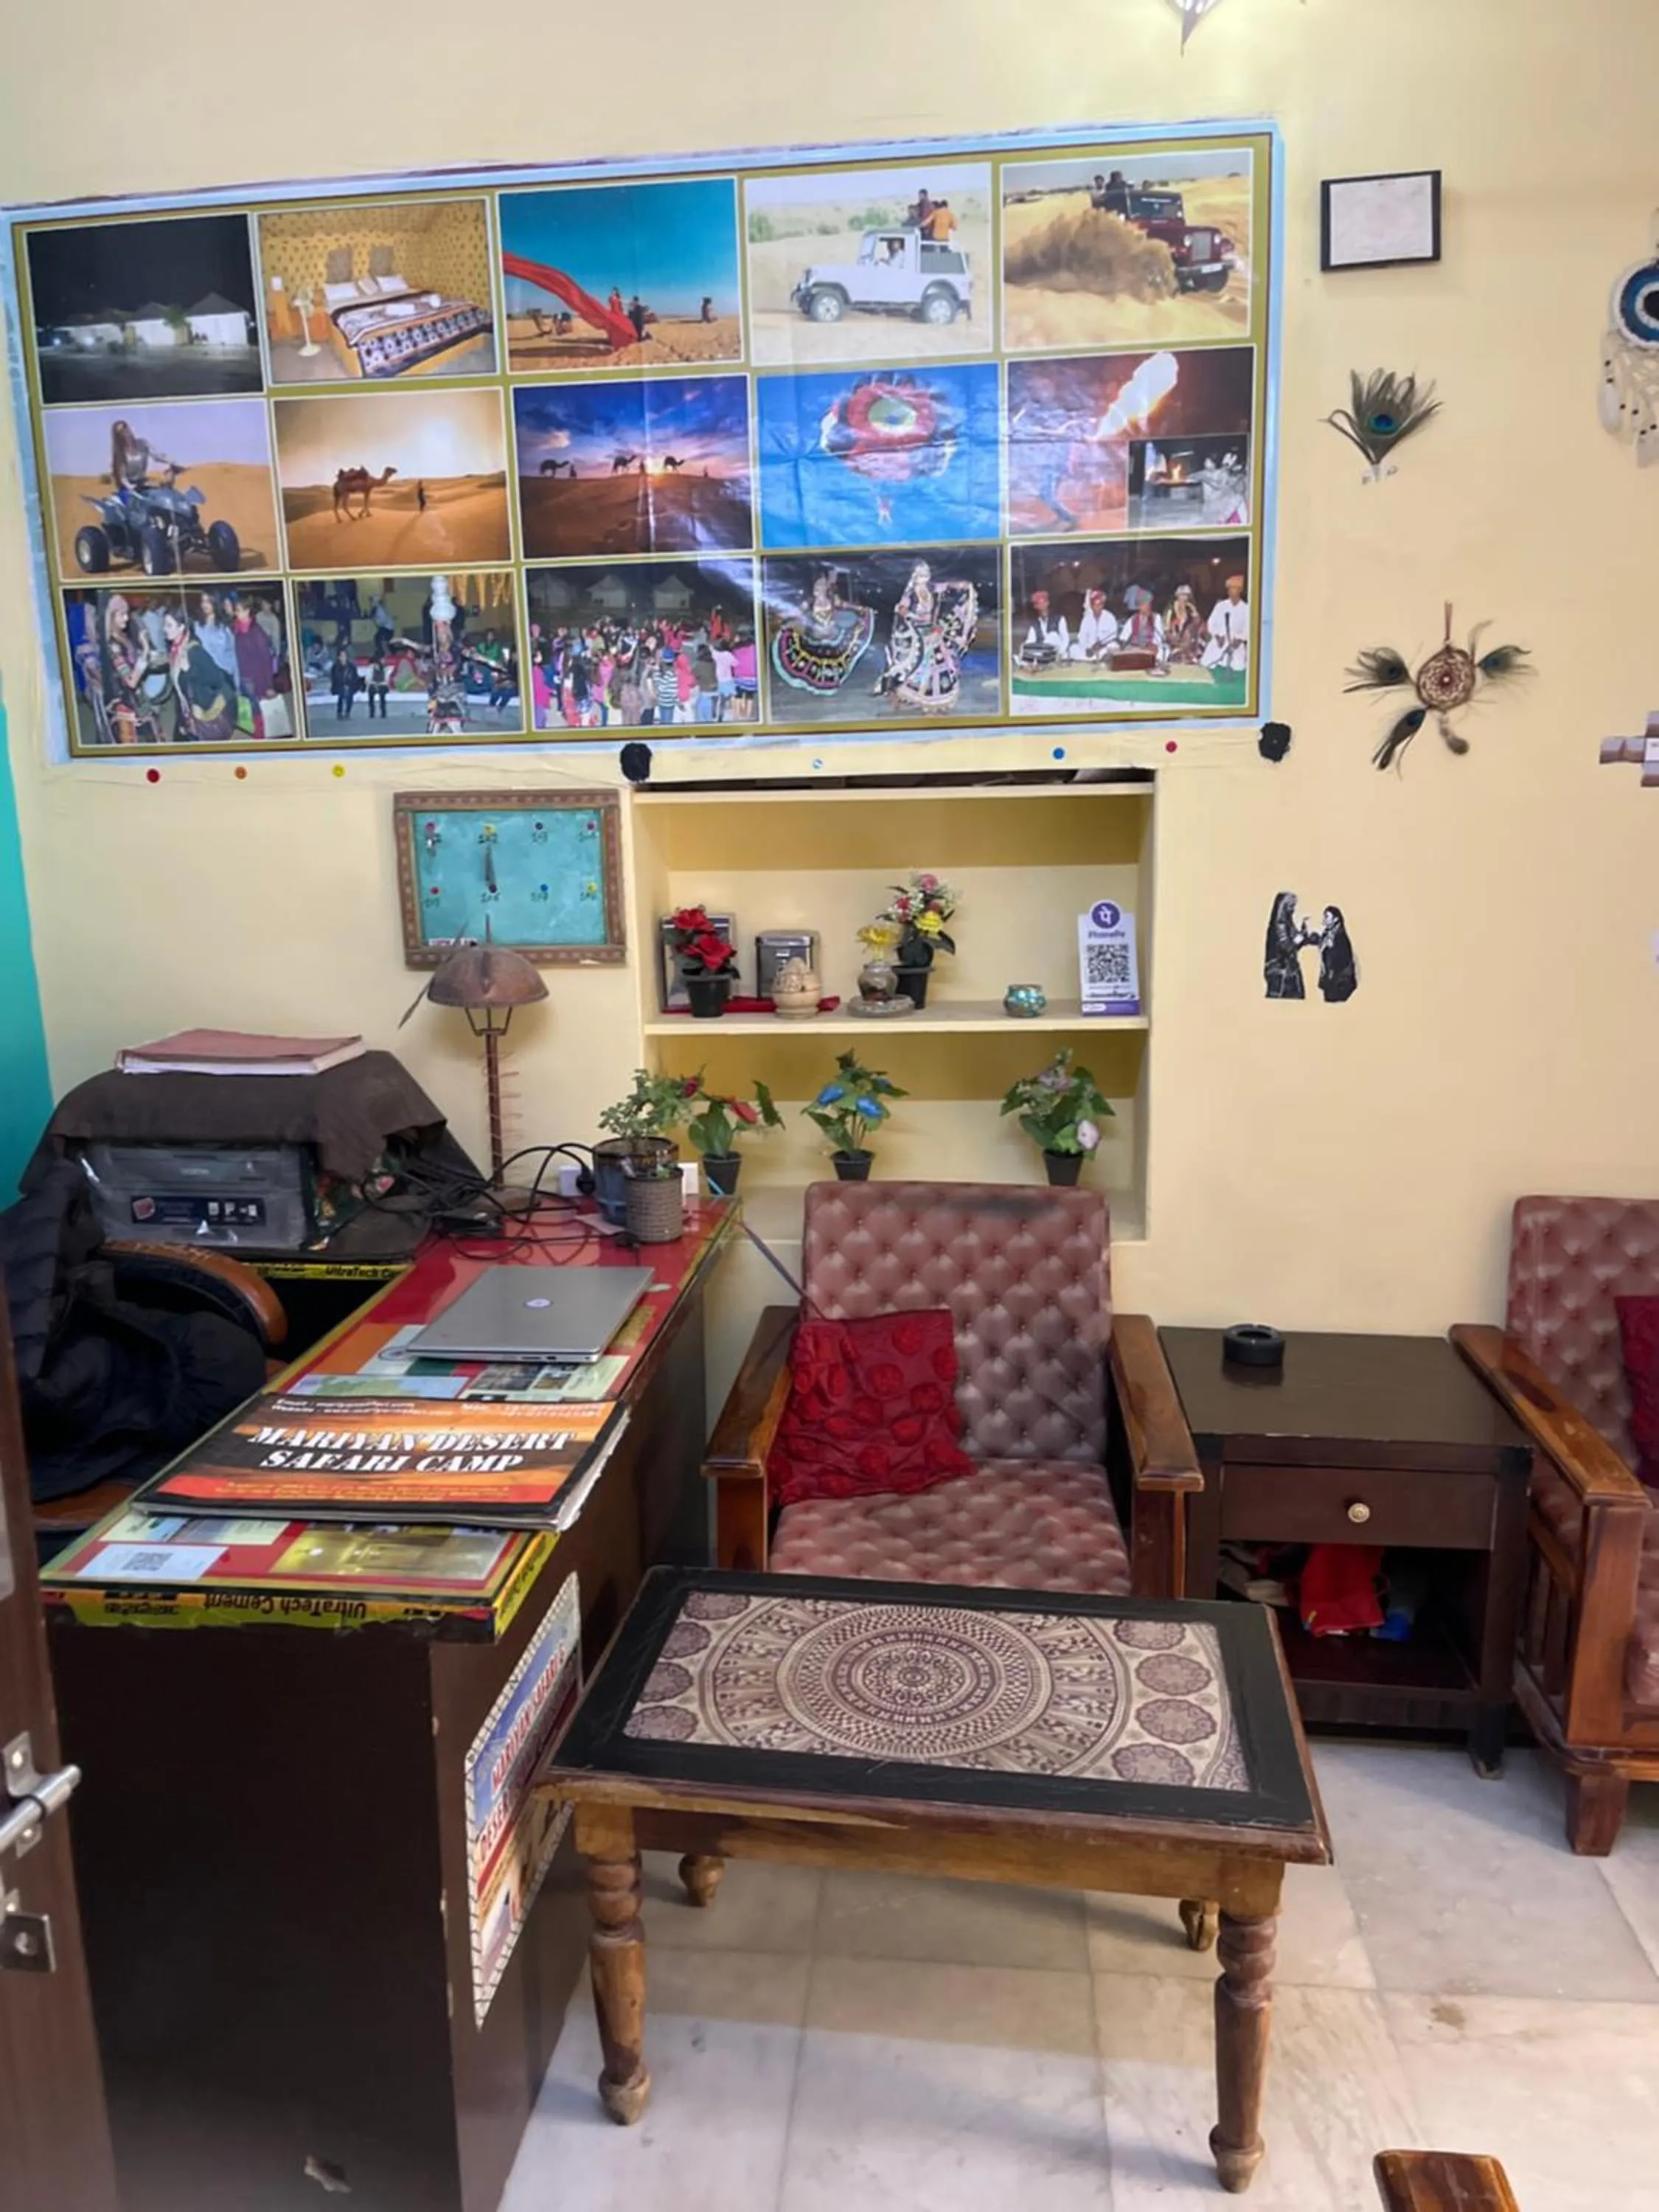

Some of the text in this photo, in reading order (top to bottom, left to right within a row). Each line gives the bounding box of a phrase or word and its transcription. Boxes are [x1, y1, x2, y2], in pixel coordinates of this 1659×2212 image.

[247, 1426, 577, 1452] MARIYAN DESERT
[259, 1450, 524, 1472] SAFARI CAMP
[205, 1593, 274, 1615] Cement
[280, 1596, 367, 1620] UltraTech
